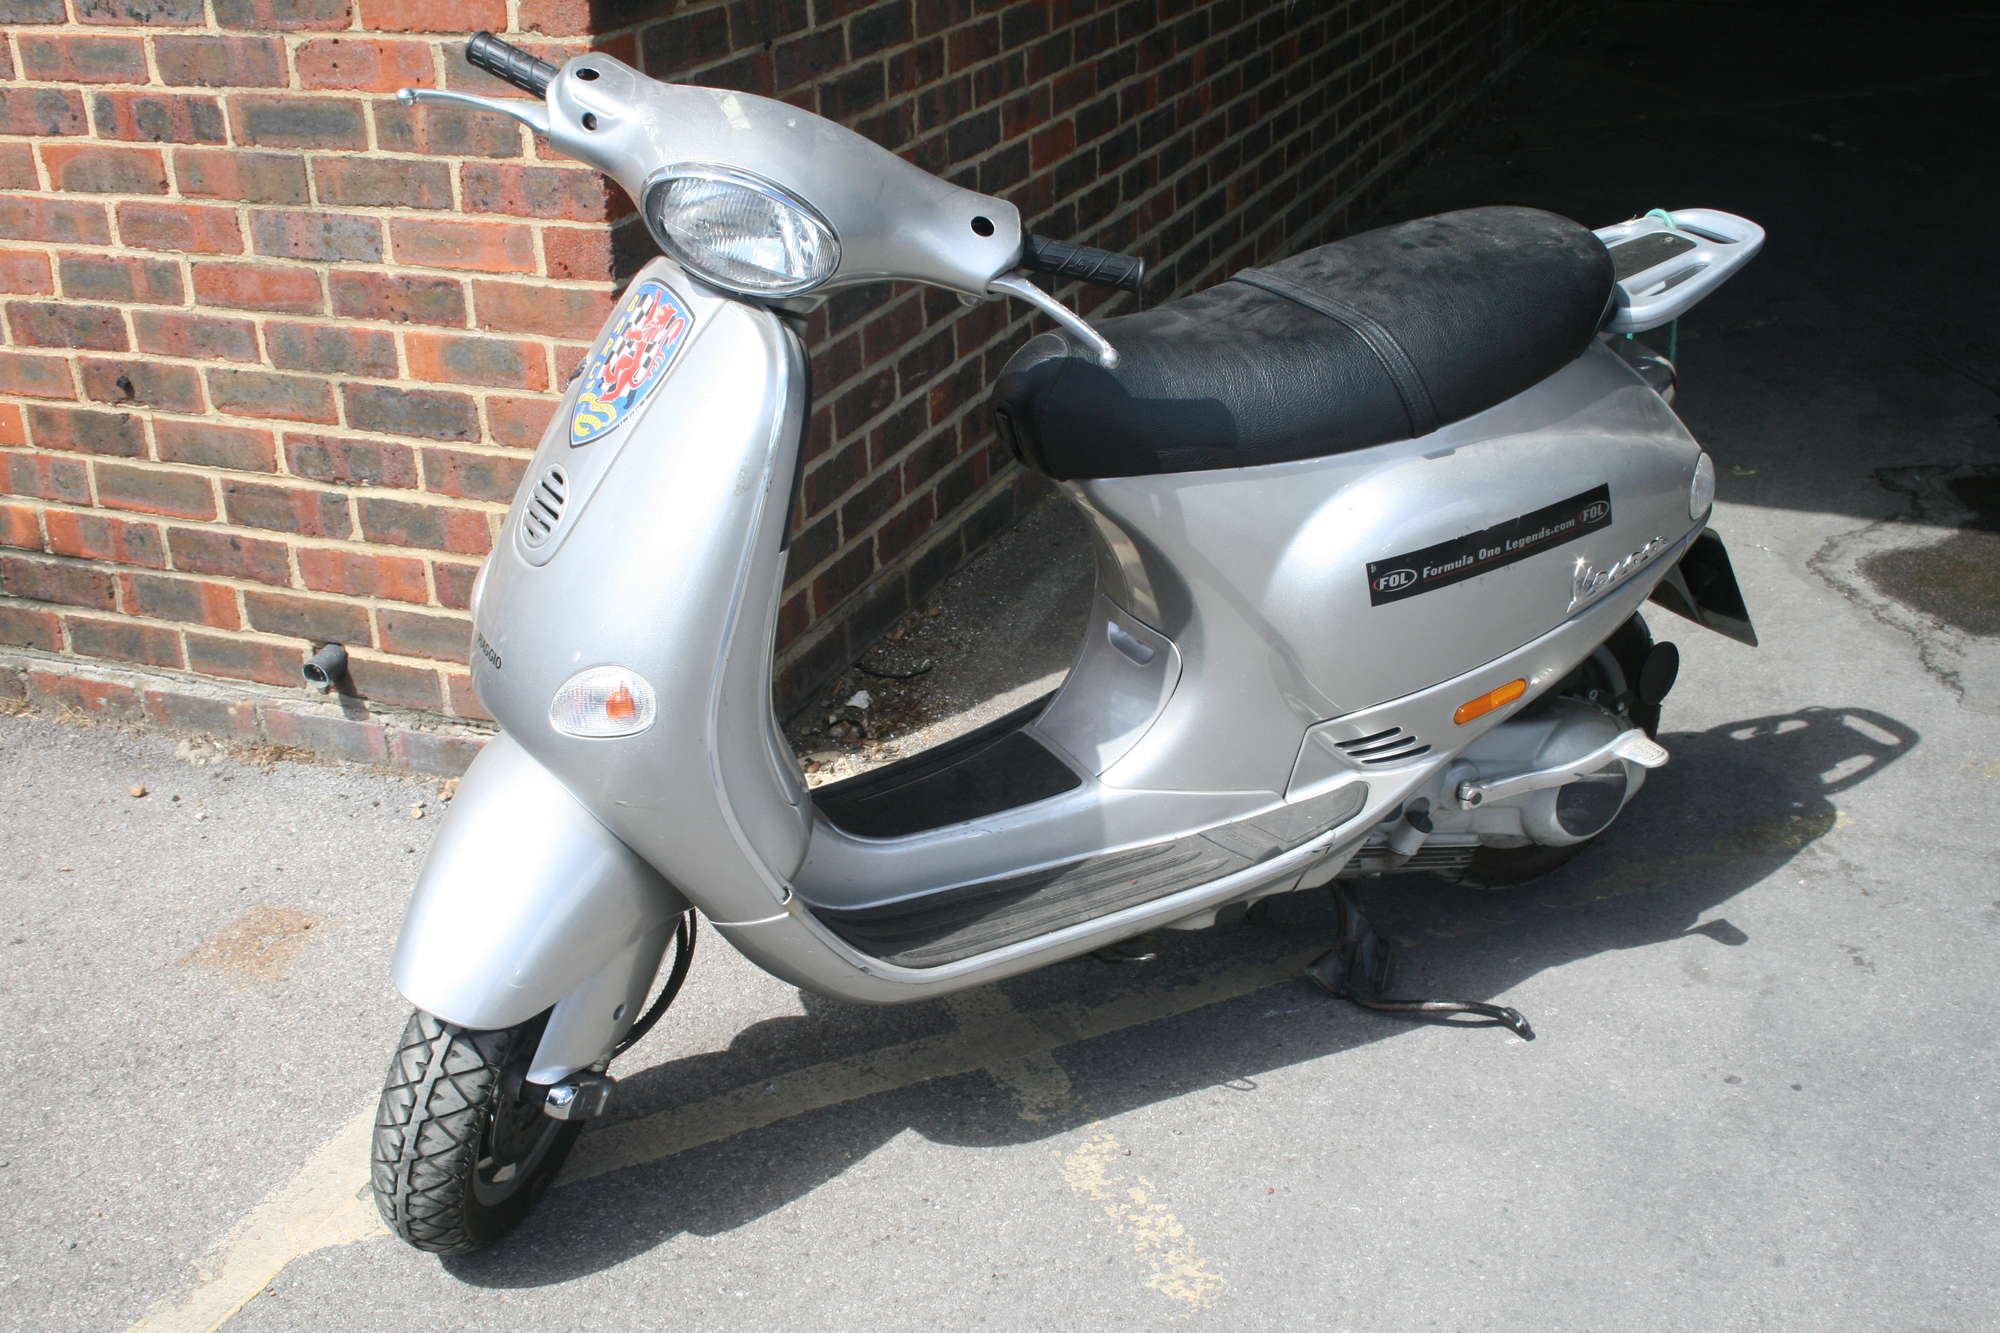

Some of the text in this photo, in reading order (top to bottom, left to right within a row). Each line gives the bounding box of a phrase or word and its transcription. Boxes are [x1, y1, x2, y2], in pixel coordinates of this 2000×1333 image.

[1379, 503, 1604, 590] FOL Formula One Legends.com FOL
